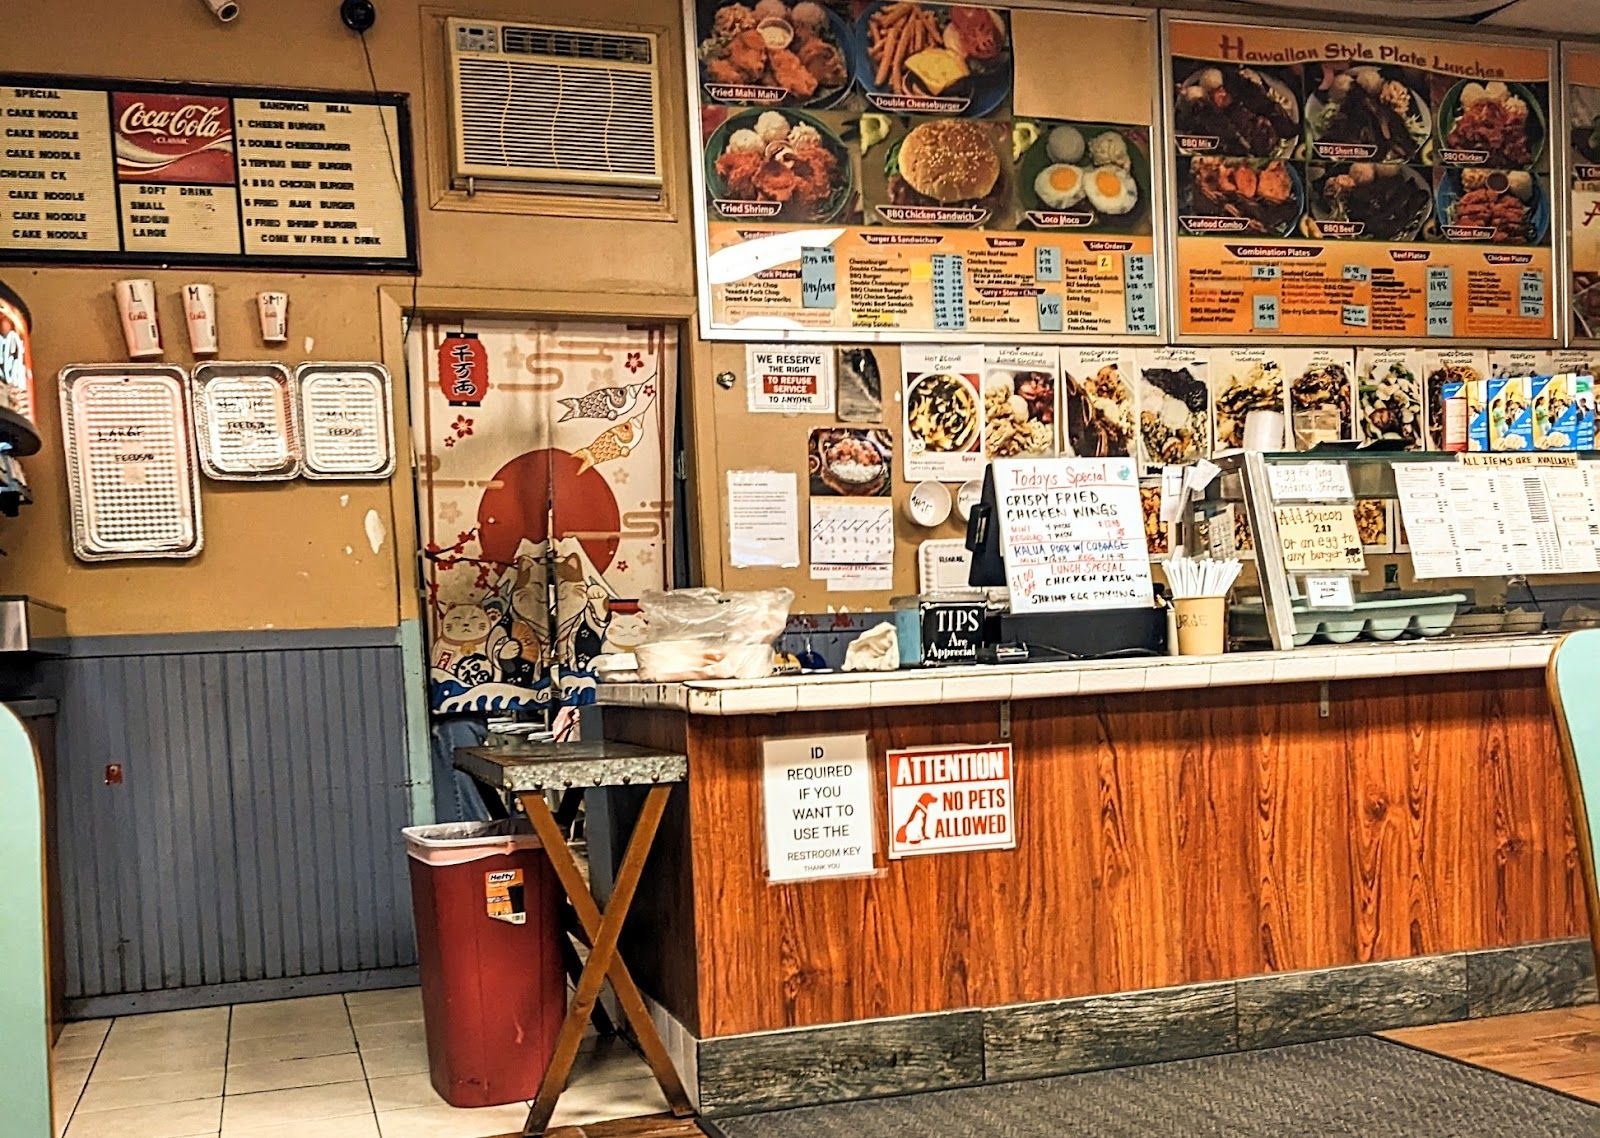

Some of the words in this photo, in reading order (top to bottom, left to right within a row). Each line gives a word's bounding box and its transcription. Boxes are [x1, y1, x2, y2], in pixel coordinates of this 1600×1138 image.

[1325, 42, 1373, 61] Style
[1380, 45, 1427, 67] Plate
[1433, 56, 1505, 78] Lunches
[15, 89, 60, 99] SPECIAL
[711, 87, 733, 97] Fried
[735, 88, 757, 98] Mahi
[758, 89, 778, 99] Mahi
[260, 102, 309, 111] SANDWICH
[326, 105, 352, 113] MEAL
[876, 97, 905, 108] Double
[906, 98, 960, 110] Cheeseburger
[8, 108, 36, 117] CAKE
[38, 111, 78, 120] NOODLE
[120, 102, 227, 137] Coca-Cola
[248, 120, 284, 129] CHEESE
[288, 121, 325, 131] BURGER
[6, 129, 34, 138] CAKE
[39, 130, 78, 139] NOODLE
[239, 139, 246, 147] 2
[248, 140, 282, 149] DOUBLE
[1182, 138, 1197, 147] BBQ
[1199, 139, 1212, 148] Mix
[7, 150, 34, 158] CAKE
[40, 151, 80, 160] NOODLE
[1320, 145, 1334, 154] BBQ
[1335, 146, 1353, 155] Short
[1444, 152, 1458, 161] BBQ
[1459, 153, 1483, 162] Chicken
[241, 159, 247, 167] 3
[319, 162, 352, 171] BURGER
[242, 179, 248, 187] 4
[280, 181, 316, 189] CHICKEN
[320, 182, 354, 190] BURGER
[9, 191, 37, 199] CAKE
[44, 192, 84, 201] NOODLE
[139, 186, 167, 195] SOFT
[180, 188, 213, 196] DRINK
[130, 202, 165, 210] SMALL
[244, 199, 250, 207] 5
[320, 201, 355, 210] BURGER
[721, 203, 743, 213] Fried
[745, 203, 774, 215] Shrimp
[13, 212, 40, 220] CAKE
[46, 213, 86, 221] NOODLE
[130, 215, 169, 224] MEDIUM
[887, 209, 904, 219] BBQ
[905, 209, 936, 220] Chicken
[937, 210, 974, 221] Sandwich
[1041, 215, 1058, 224] Loco
[1059, 216, 1080, 225] Moco
[323, 221, 357, 229] BURGER
[1188, 219, 1217, 229] Seafood
[1218, 220, 1243, 230] Combo
[1323, 224, 1338, 233] BBQ
[1339, 224, 1355, 233] Beef
[13, 230, 41, 239] CAKE
[47, 231, 88, 240] NOODLE
[133, 229, 167, 237] LARGE
[1447, 229, 1471, 237] Chicken
[1472, 229, 1490, 238] Katsu
[311, 236, 337, 244] FRIES
[1237, 247, 1286, 256] Combination
[1287, 248, 1311, 257] Plates
[1408, 252, 1426, 260] Plates
[129, 284, 142, 302] L
[188, 287, 200, 301] M
[757, 355, 772, 364] WE
[776, 355, 821, 364] RESERVE
[451, 344, 475, 396] 千万両
[780, 376, 812, 384] REFUSE
[773, 385, 807, 393] SERVICE
[1463, 458, 1478, 466] ALL
[1483, 457, 1513, 466] ITEMS
[1537, 458, 1577, 466] AVAILABLE
[1012, 466, 1058, 491] Todays
[1066, 464, 1107, 487] Special
[1007, 494, 1049, 506] CRISPY
[1056, 491, 1099, 504] FRIED
[1007, 508, 1066, 521] CHICKEN
[1074, 504, 1118, 518] WINGS
[1280, 508, 1304, 525] Add
[1305, 508, 1342, 523] Bacon
[1011, 525, 1030, 533] MINI
[1300, 540, 1315, 548] an
[1318, 537, 1339, 549] egg
[1342, 533, 1354, 544] to
[1014, 545, 1045, 557] KALUA
[1287, 553, 1306, 565] any
[1311, 550, 1342, 562] burger
[1051, 563, 1080, 574] LUNCH
[1084, 562, 1125, 573] SPECIAL
[1046, 575, 1096, 586] CHICKEN
[1102, 574, 1131, 582] KATSU
[1032, 594, 1066, 604] SHRIMP
[936, 609, 979, 632] TIPS
[948, 632, 968, 648] Are
[811, 747, 824, 759] ID
[787, 765, 853, 780] REQUIRED
[896, 751, 1004, 785] ATTENTION
[799, 788, 811, 800] IF
[814, 786, 841, 799] YOU
[943, 792, 963, 812] NO
[968, 788, 1006, 810] PETS
[792, 806, 836, 820] WANT
[838, 804, 854, 817] TO
[935, 814, 1006, 839] ALLOWED
[793, 827, 823, 841] USE
[825, 825, 850, 838] THE
[787, 849, 841, 861] RESTROOM
[843, 847, 861, 857] KEY
[804, 864, 826, 872] THANK
[491, 873, 513, 881] Hefty
